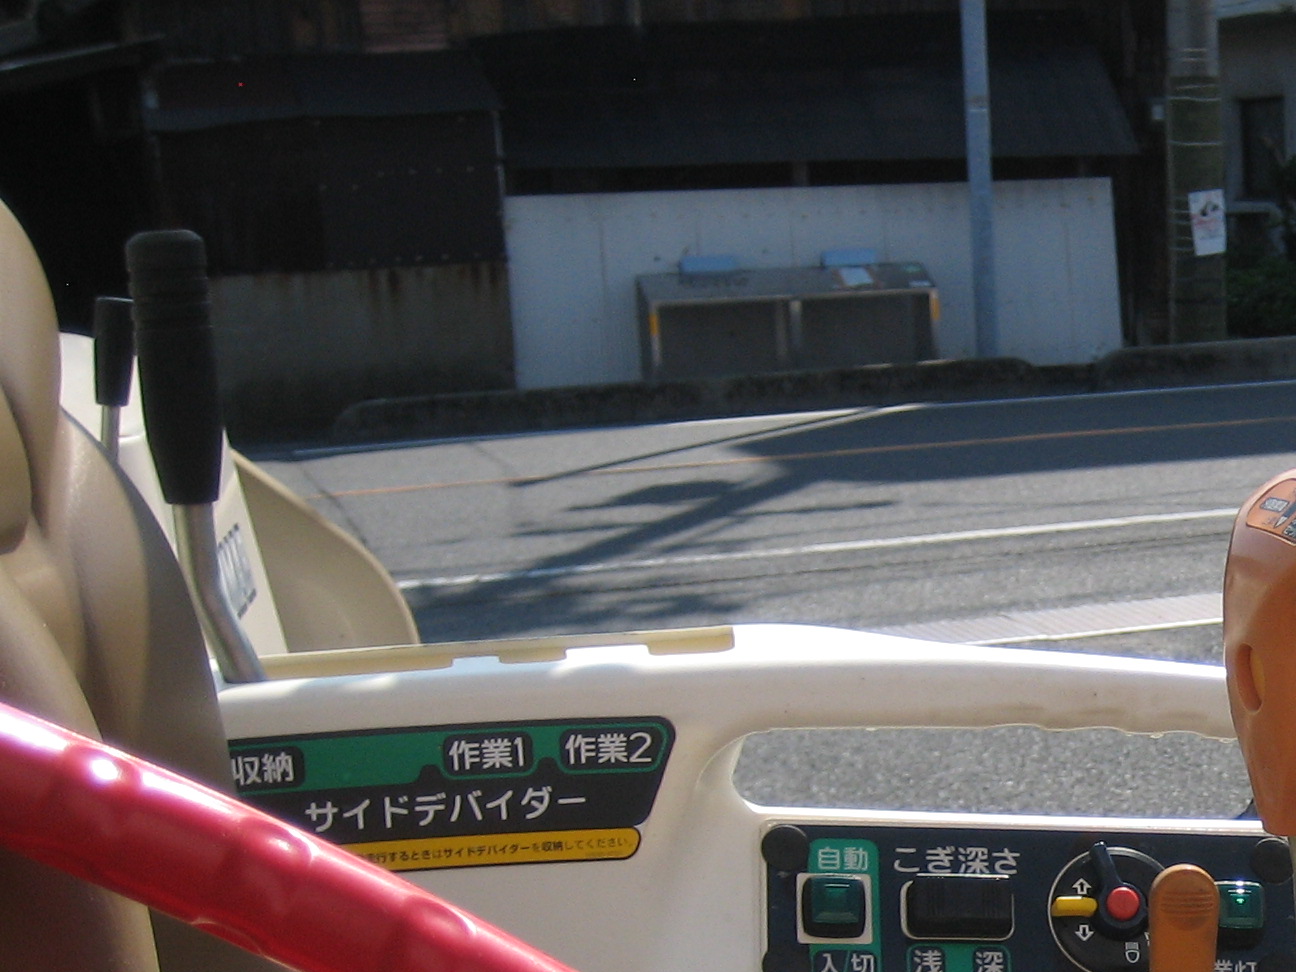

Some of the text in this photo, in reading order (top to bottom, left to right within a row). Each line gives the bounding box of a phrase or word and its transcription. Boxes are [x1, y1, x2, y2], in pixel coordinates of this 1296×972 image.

[448, 735, 526, 773] 作業1
[564, 731, 653, 766] 作業2
[231, 751, 295, 786] 収納
[305, 788, 588, 833] サイドデバイダー
[817, 846, 869, 872] 自動
[893, 846, 1021, 875] こぎ深さ
